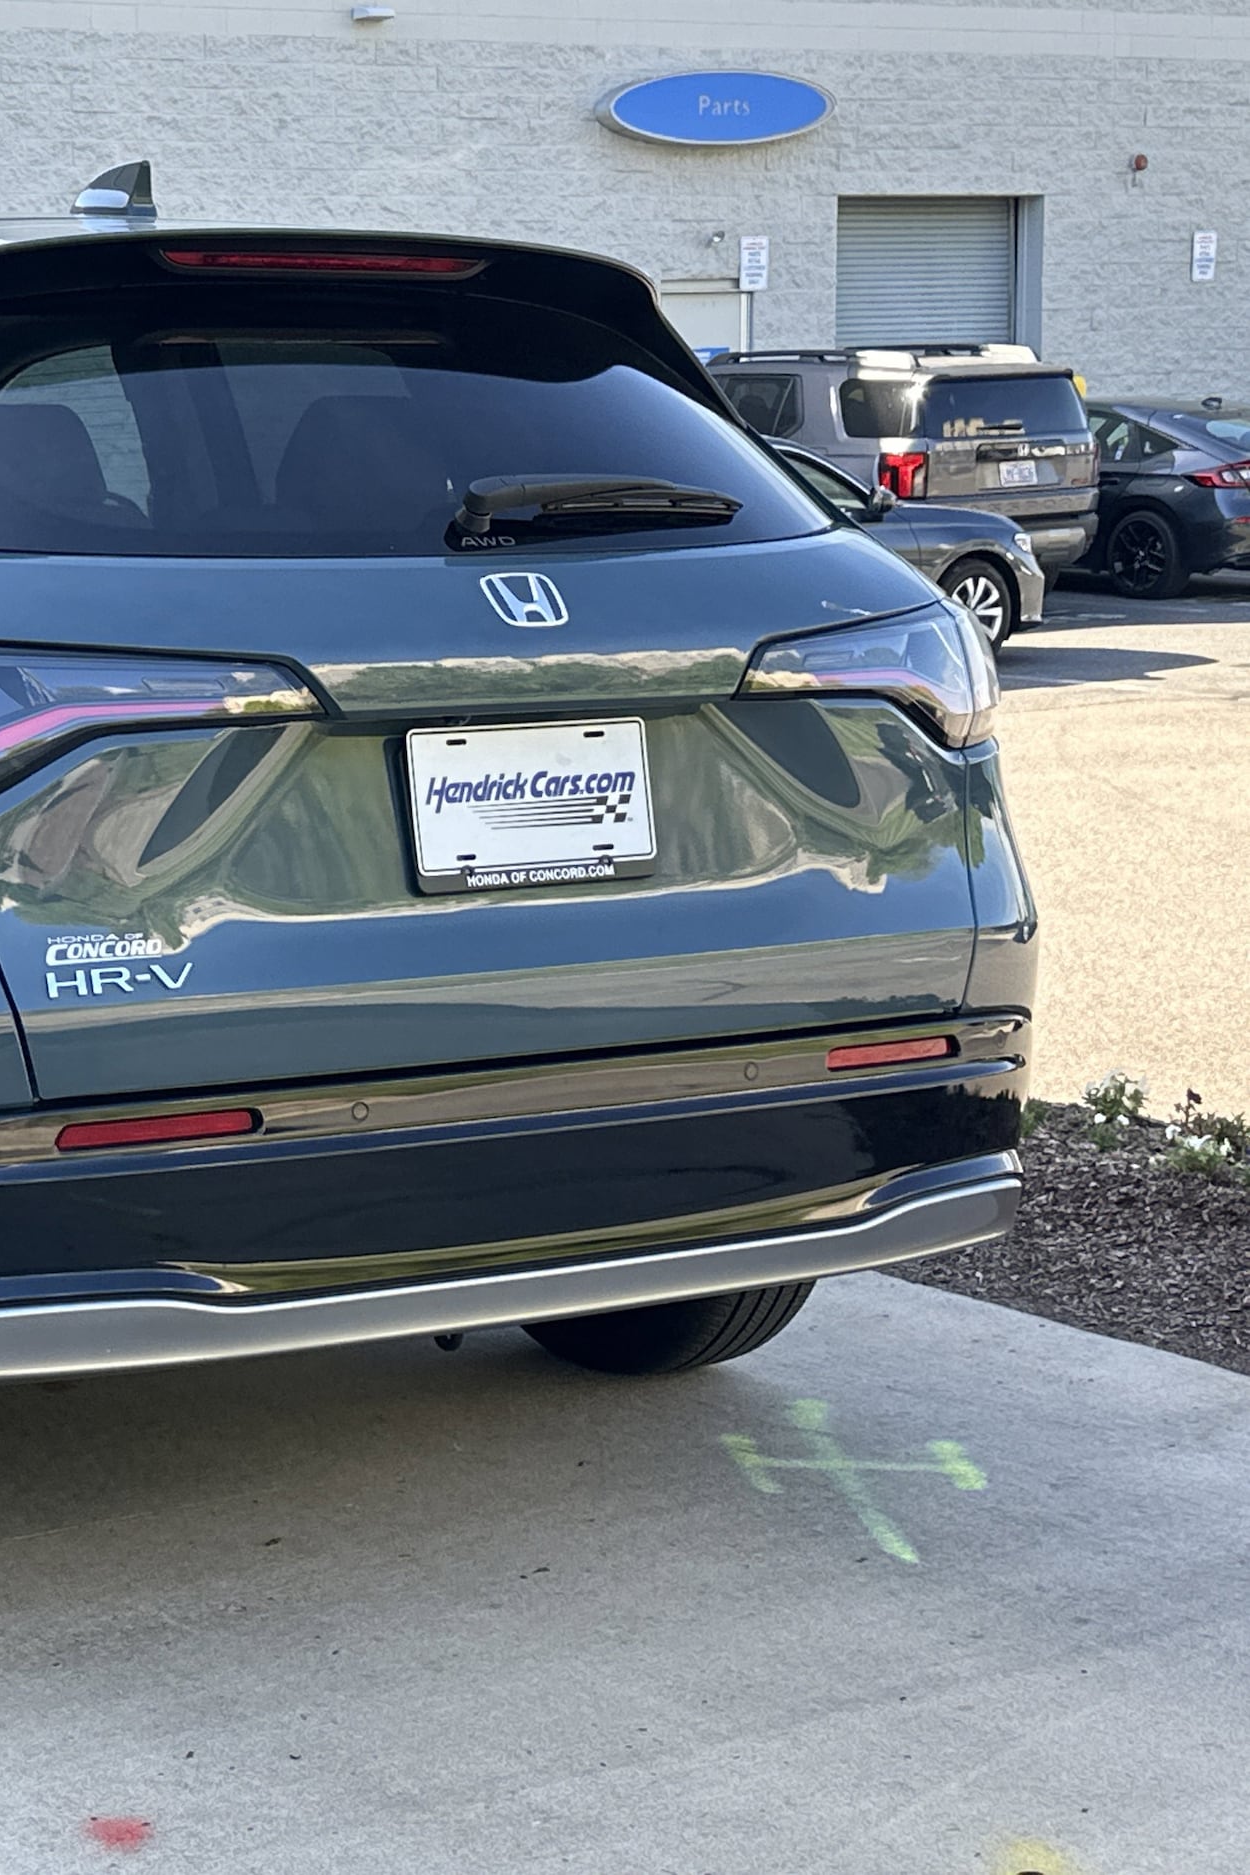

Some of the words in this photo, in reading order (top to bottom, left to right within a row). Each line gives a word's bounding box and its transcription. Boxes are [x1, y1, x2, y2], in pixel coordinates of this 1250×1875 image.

[698, 95, 750, 115] Parts
[461, 536, 516, 547] AWD
[466, 872, 509, 887] HONDA
[511, 871, 527, 884] OF
[530, 864, 615, 883] CONCORD.COM
[47, 933, 119, 944] HONDA
[124, 932, 144, 941] OF
[46, 939, 162, 966] CONCORD
[45, 962, 193, 999] HR-V
